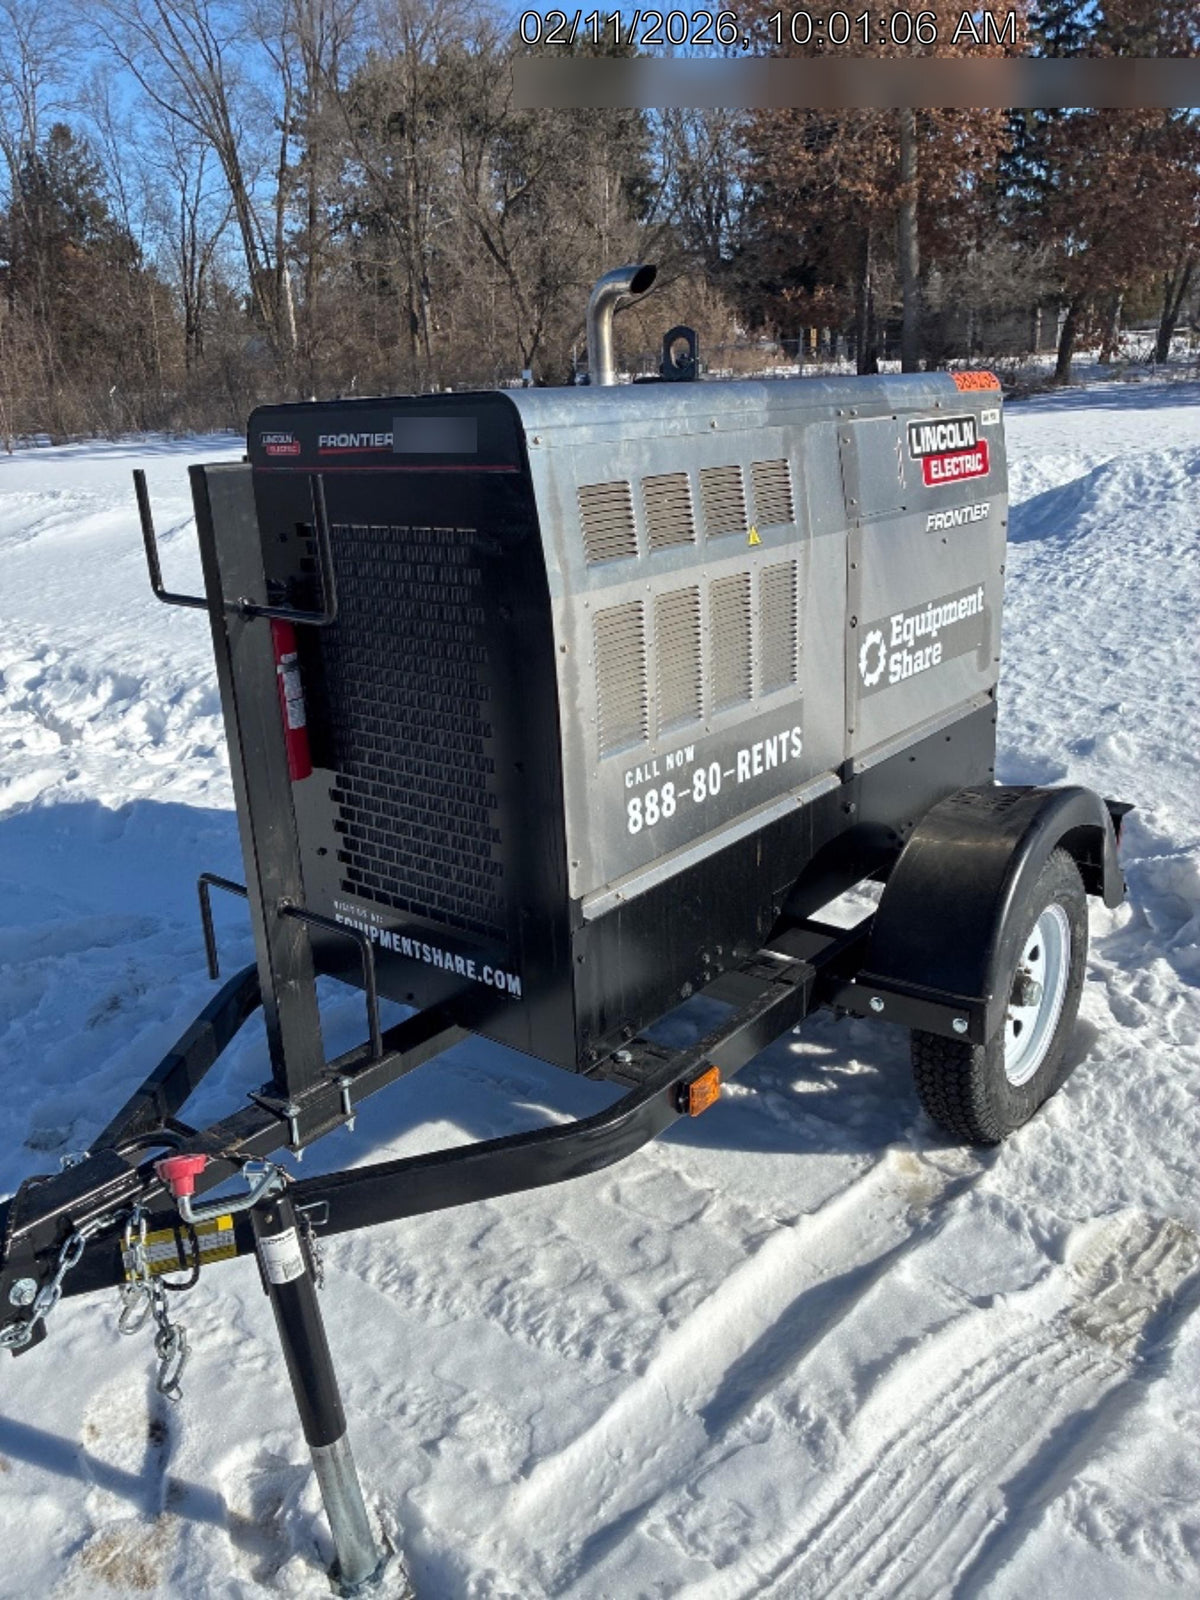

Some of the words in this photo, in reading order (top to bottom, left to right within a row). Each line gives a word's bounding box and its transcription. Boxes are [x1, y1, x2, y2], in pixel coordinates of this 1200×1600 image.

[318, 433, 393, 447] FRONTIER
[911, 421, 975, 454] LINCOLN
[930, 453, 983, 479] ELECTRIC
[926, 502, 990, 533] FRONTIER
[890, 586, 984, 647] Equipment
[889, 641, 942, 684] Share
[625, 761, 660, 788] CALL
[666, 745, 695, 771] NOW
[627, 726, 802, 834] 888-80-RENTS
